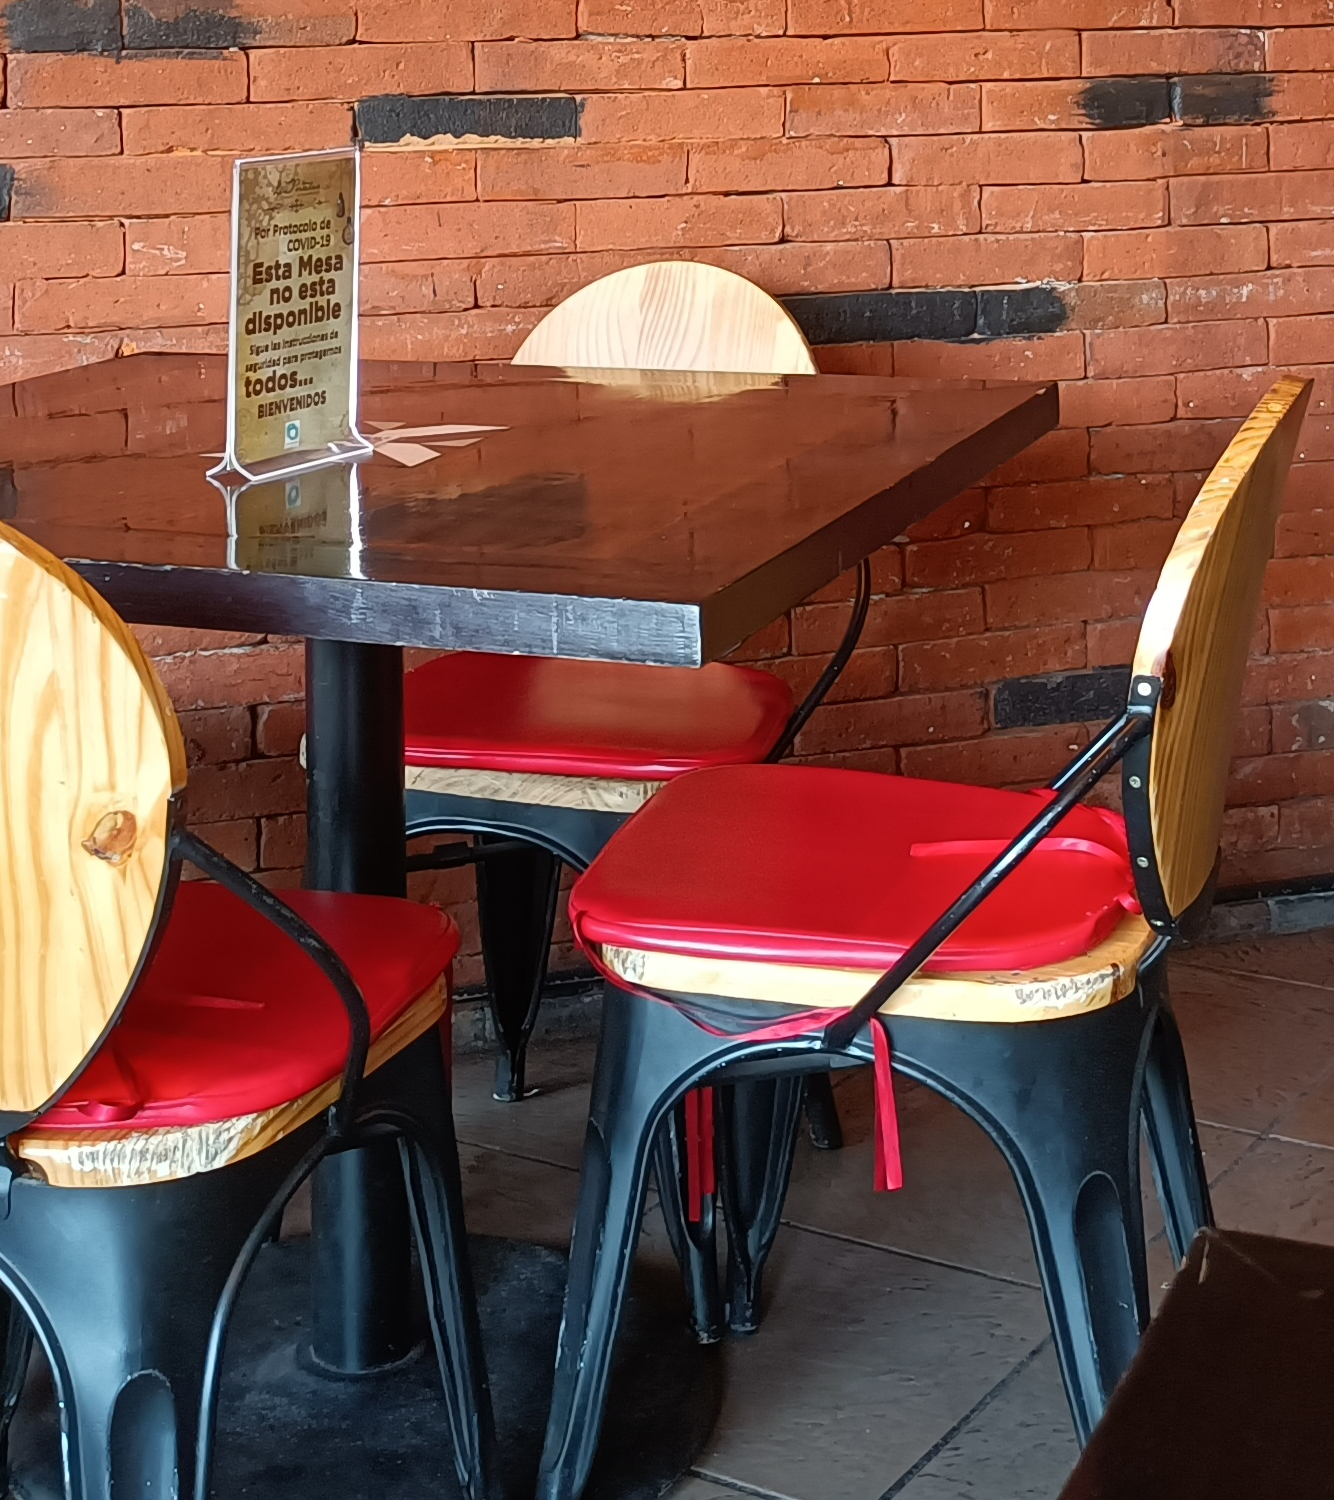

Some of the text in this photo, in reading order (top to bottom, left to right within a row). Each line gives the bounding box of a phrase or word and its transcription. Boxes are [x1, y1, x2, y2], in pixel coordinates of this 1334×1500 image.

[254, 217, 331, 240] Por Protocolo de
[287, 233, 331, 252] COVID-19
[252, 254, 344, 285] Esta Mesa
[269, 276, 336, 306] no esta
[244, 298, 342, 335] disponible
[244, 369, 313, 398] todos...
[257, 390, 327, 419] BIENVENIDOS
